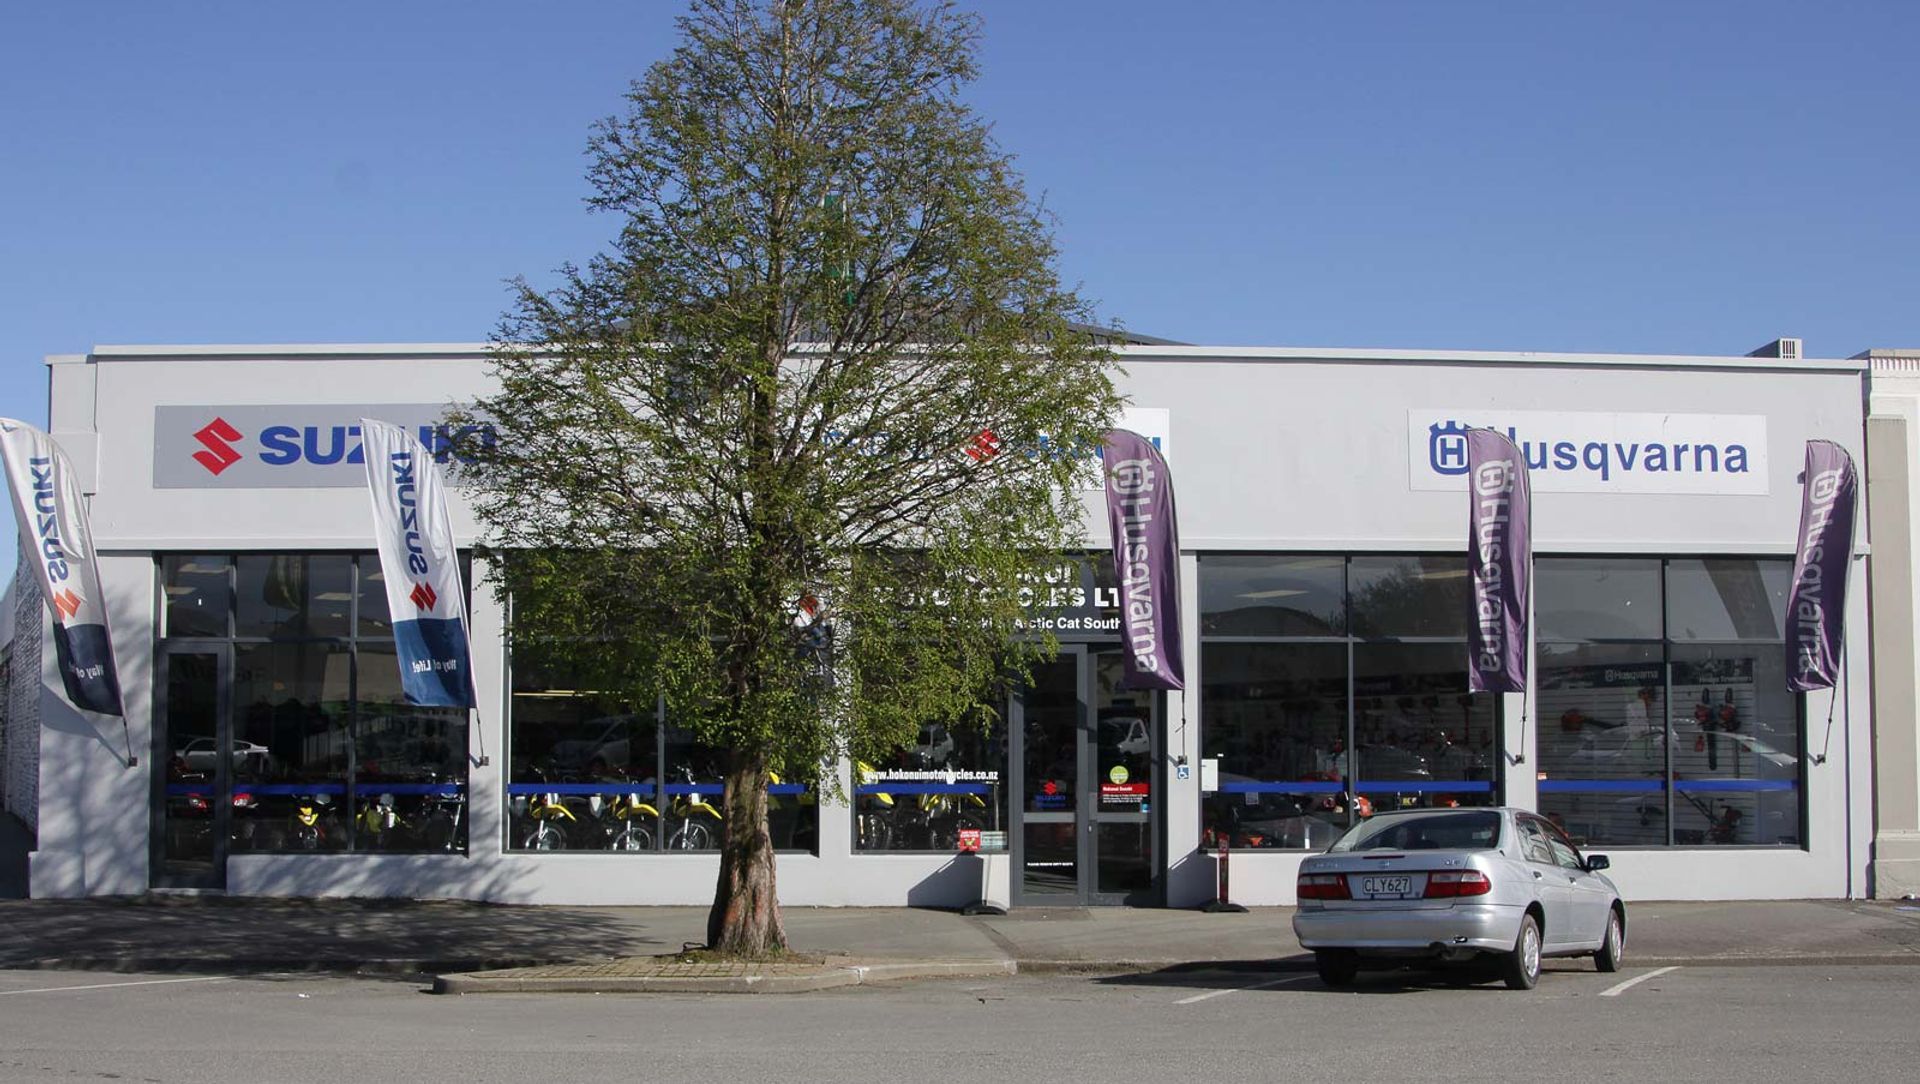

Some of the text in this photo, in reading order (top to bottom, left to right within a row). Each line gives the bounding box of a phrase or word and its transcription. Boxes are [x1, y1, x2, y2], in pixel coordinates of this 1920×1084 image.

[1120, 499, 1158, 674] Husqvarna
[1475, 498, 1508, 673] Husqvarna
[1796, 502, 1834, 673] Husqvarna
[1057, 617, 1081, 630] Cat
[1613, 670, 1659, 681] Husqvarna
[862, 768, 999, 781] www.hokonuimotorcles.co.nz
[1364, 877, 1409, 893] CLY627
